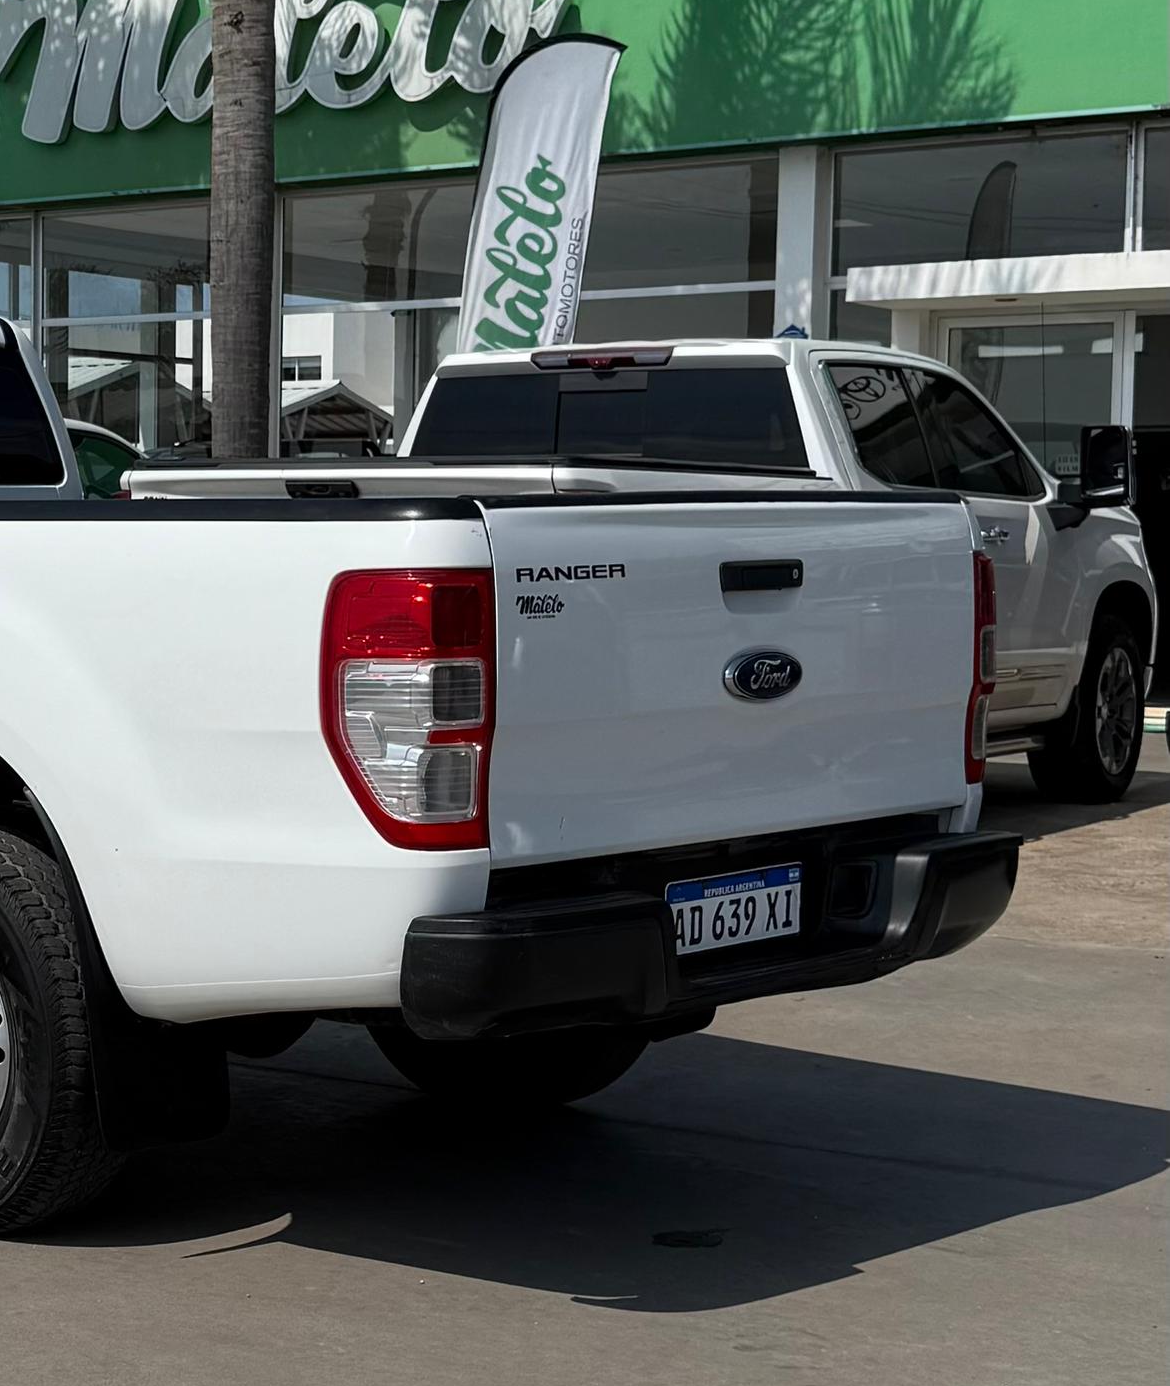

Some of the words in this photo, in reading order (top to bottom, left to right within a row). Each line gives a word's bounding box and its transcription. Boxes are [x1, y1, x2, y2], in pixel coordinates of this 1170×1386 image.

[553, 217, 585, 345] TOMOTORES
[516, 564, 626, 582] RANGER
[751, 659, 790, 690] Ford
[735, 879, 765, 893] ARGENTINA
[674, 905, 703, 947] AD
[712, 896, 756, 941] 639
[766, 889, 793, 932] XI
